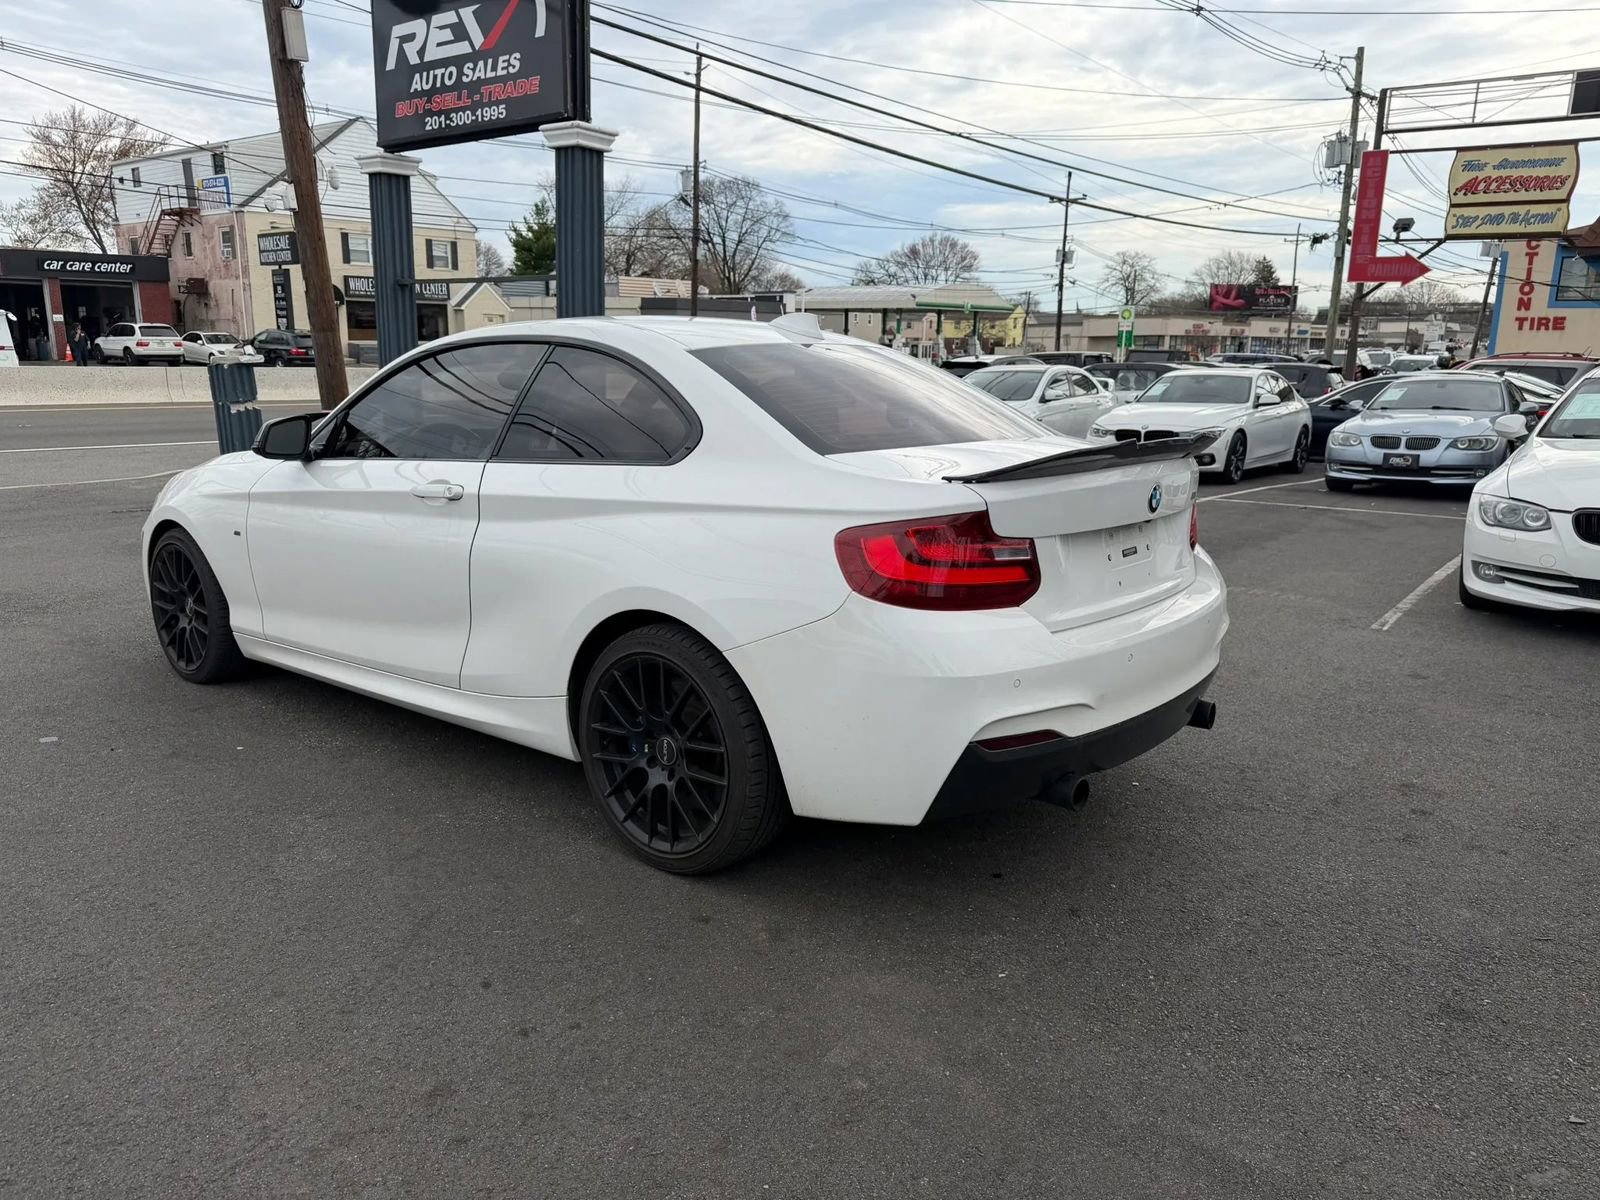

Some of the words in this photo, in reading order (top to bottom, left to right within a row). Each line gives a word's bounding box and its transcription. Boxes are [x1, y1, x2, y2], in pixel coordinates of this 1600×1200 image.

[410, 66, 457, 92] AUTO
[461, 52, 520, 83] SALES
[425, 104, 506, 131] 201-300-1995
[1453, 174, 1571, 196] ACCESSORIES
[258, 235, 290, 251] WHOLESALE
[44, 260, 64, 270] car
[66, 261, 92, 271] care
[94, 262, 133, 273] center
[421, 282, 448, 295] CENTER
[1515, 316, 1567, 331] TIRE
